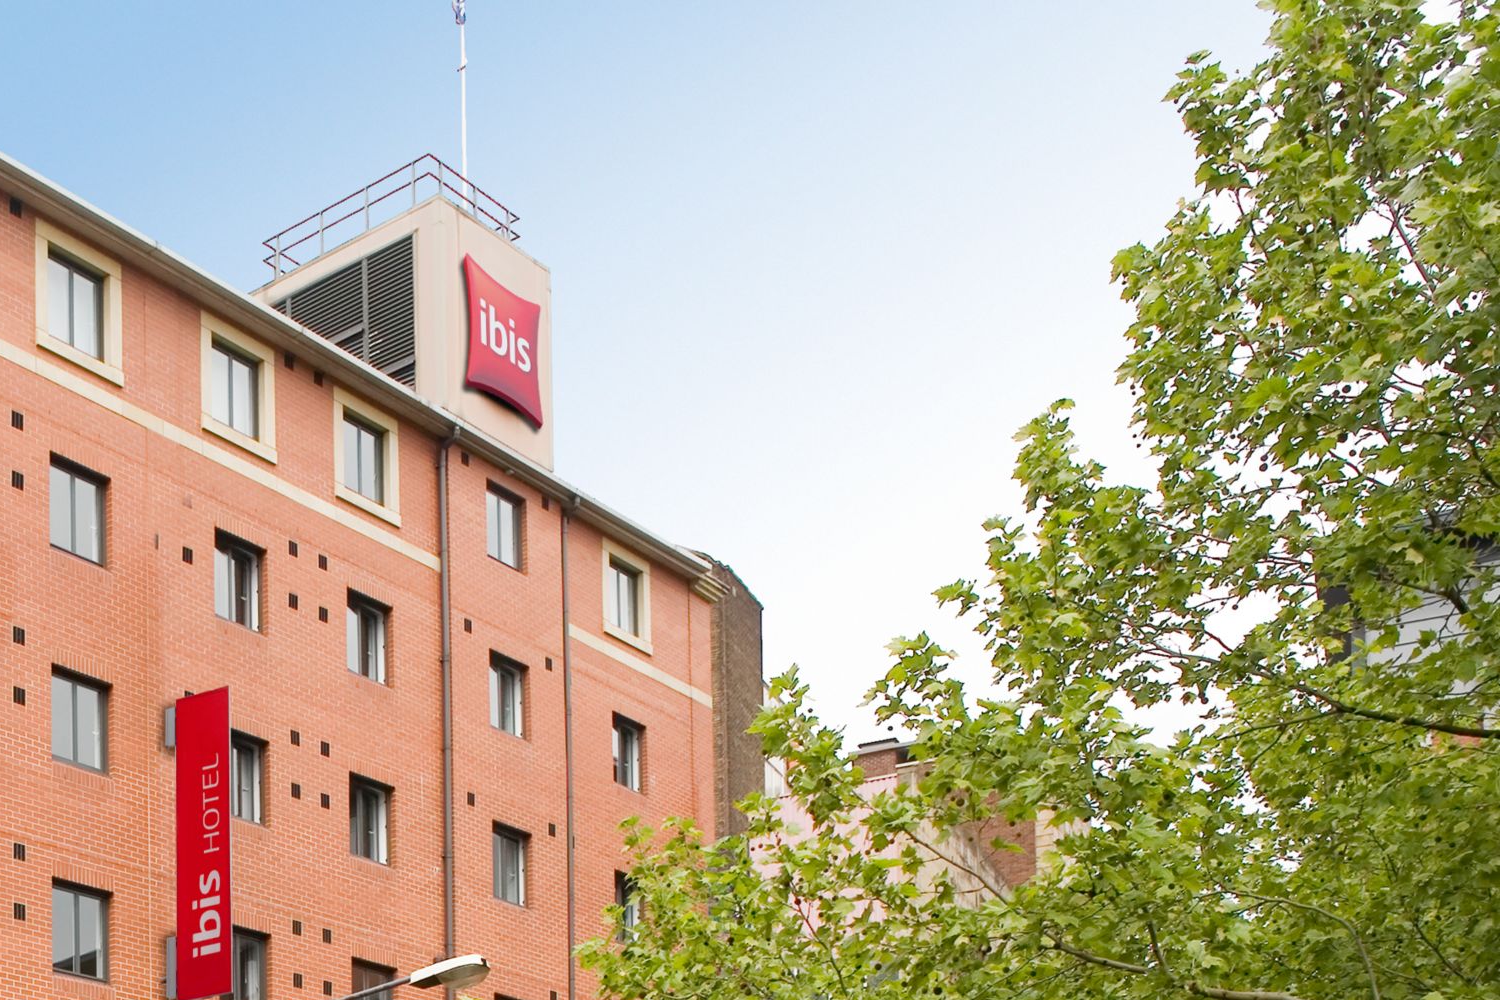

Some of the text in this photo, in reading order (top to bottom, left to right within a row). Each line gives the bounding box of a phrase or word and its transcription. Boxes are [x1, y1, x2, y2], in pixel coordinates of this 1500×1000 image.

[479, 297, 532, 374] ibis
[192, 752, 221, 959] ibis HOTEL
